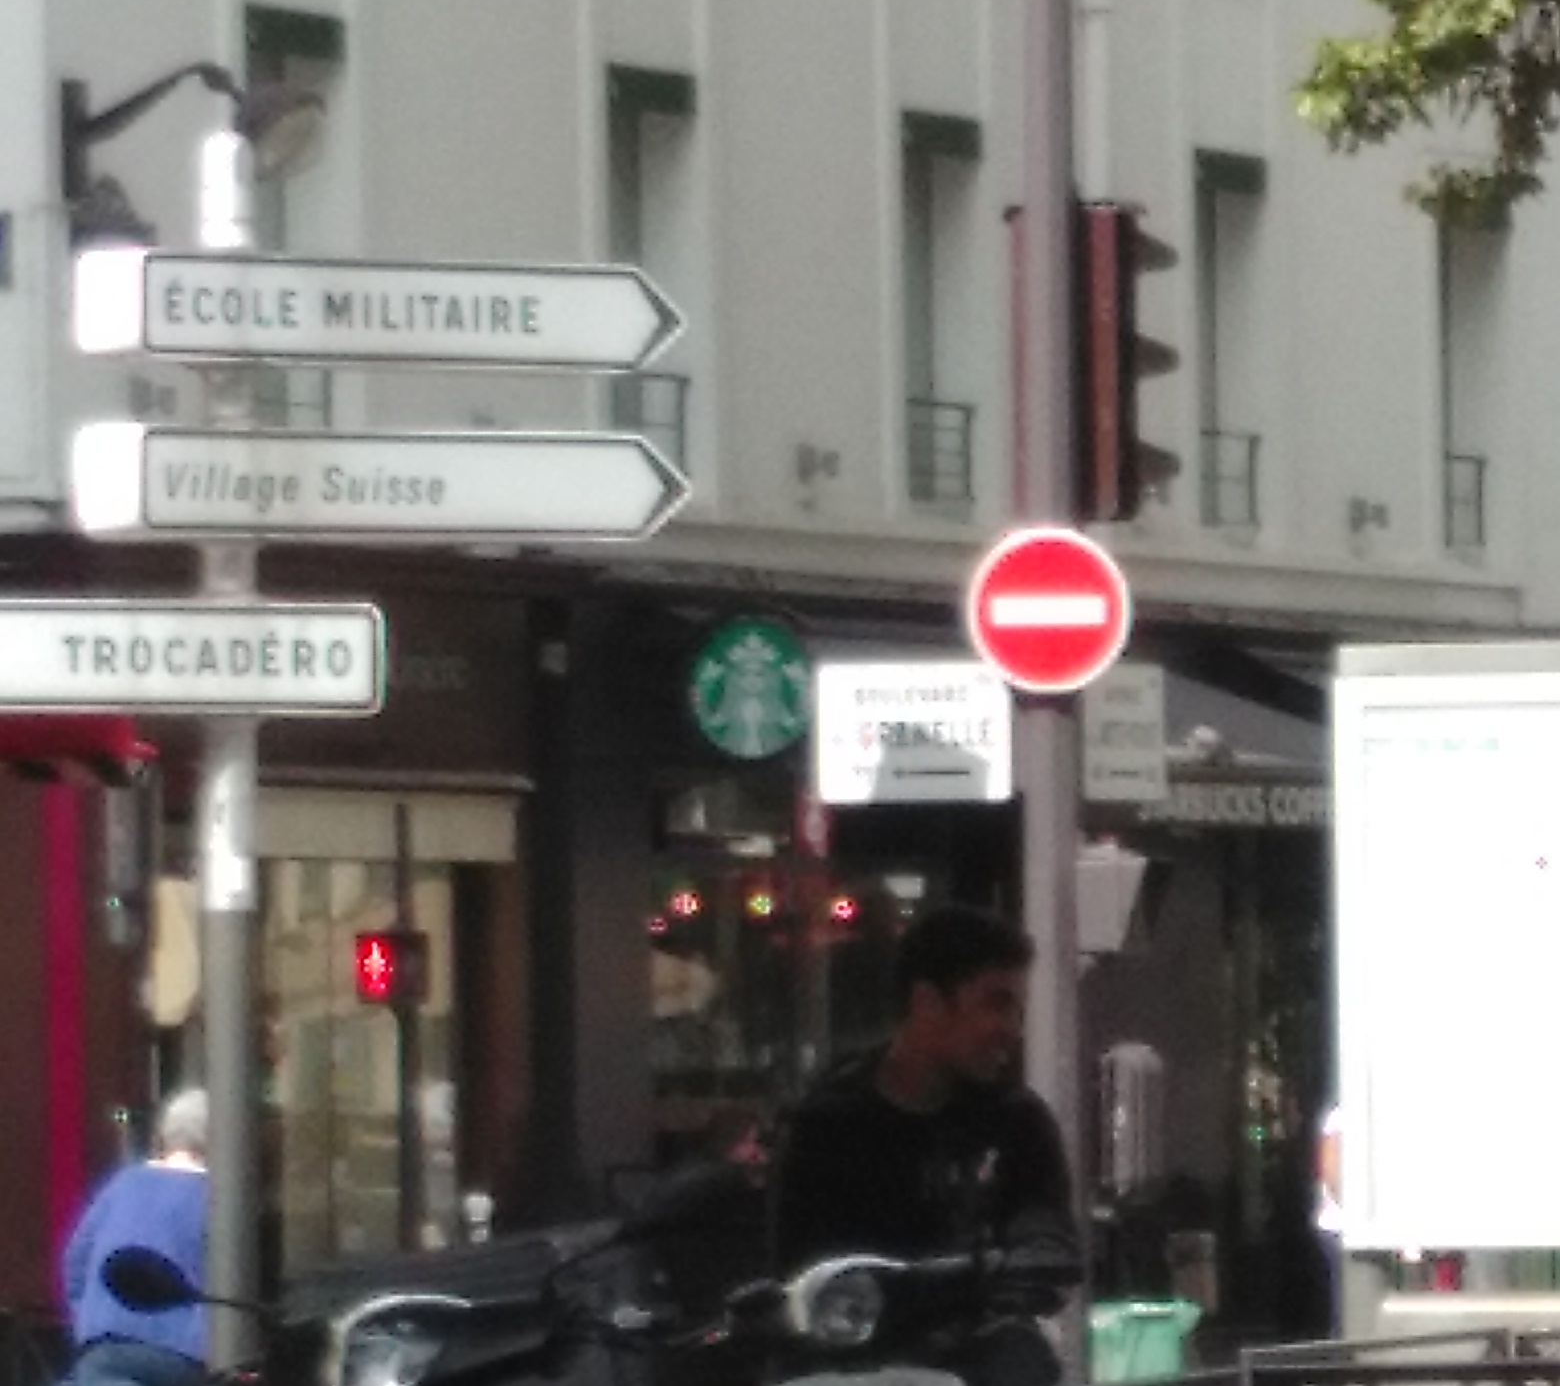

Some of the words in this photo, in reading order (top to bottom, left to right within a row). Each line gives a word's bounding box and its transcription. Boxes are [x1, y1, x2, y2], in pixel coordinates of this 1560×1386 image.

[163, 279, 299, 329] ÉCOLE
[322, 291, 542, 334] MILITAIRE
[164, 463, 300, 512] Village
[321, 465, 448, 507] Suisse
[62, 631, 354, 679] TROCADÉRO
